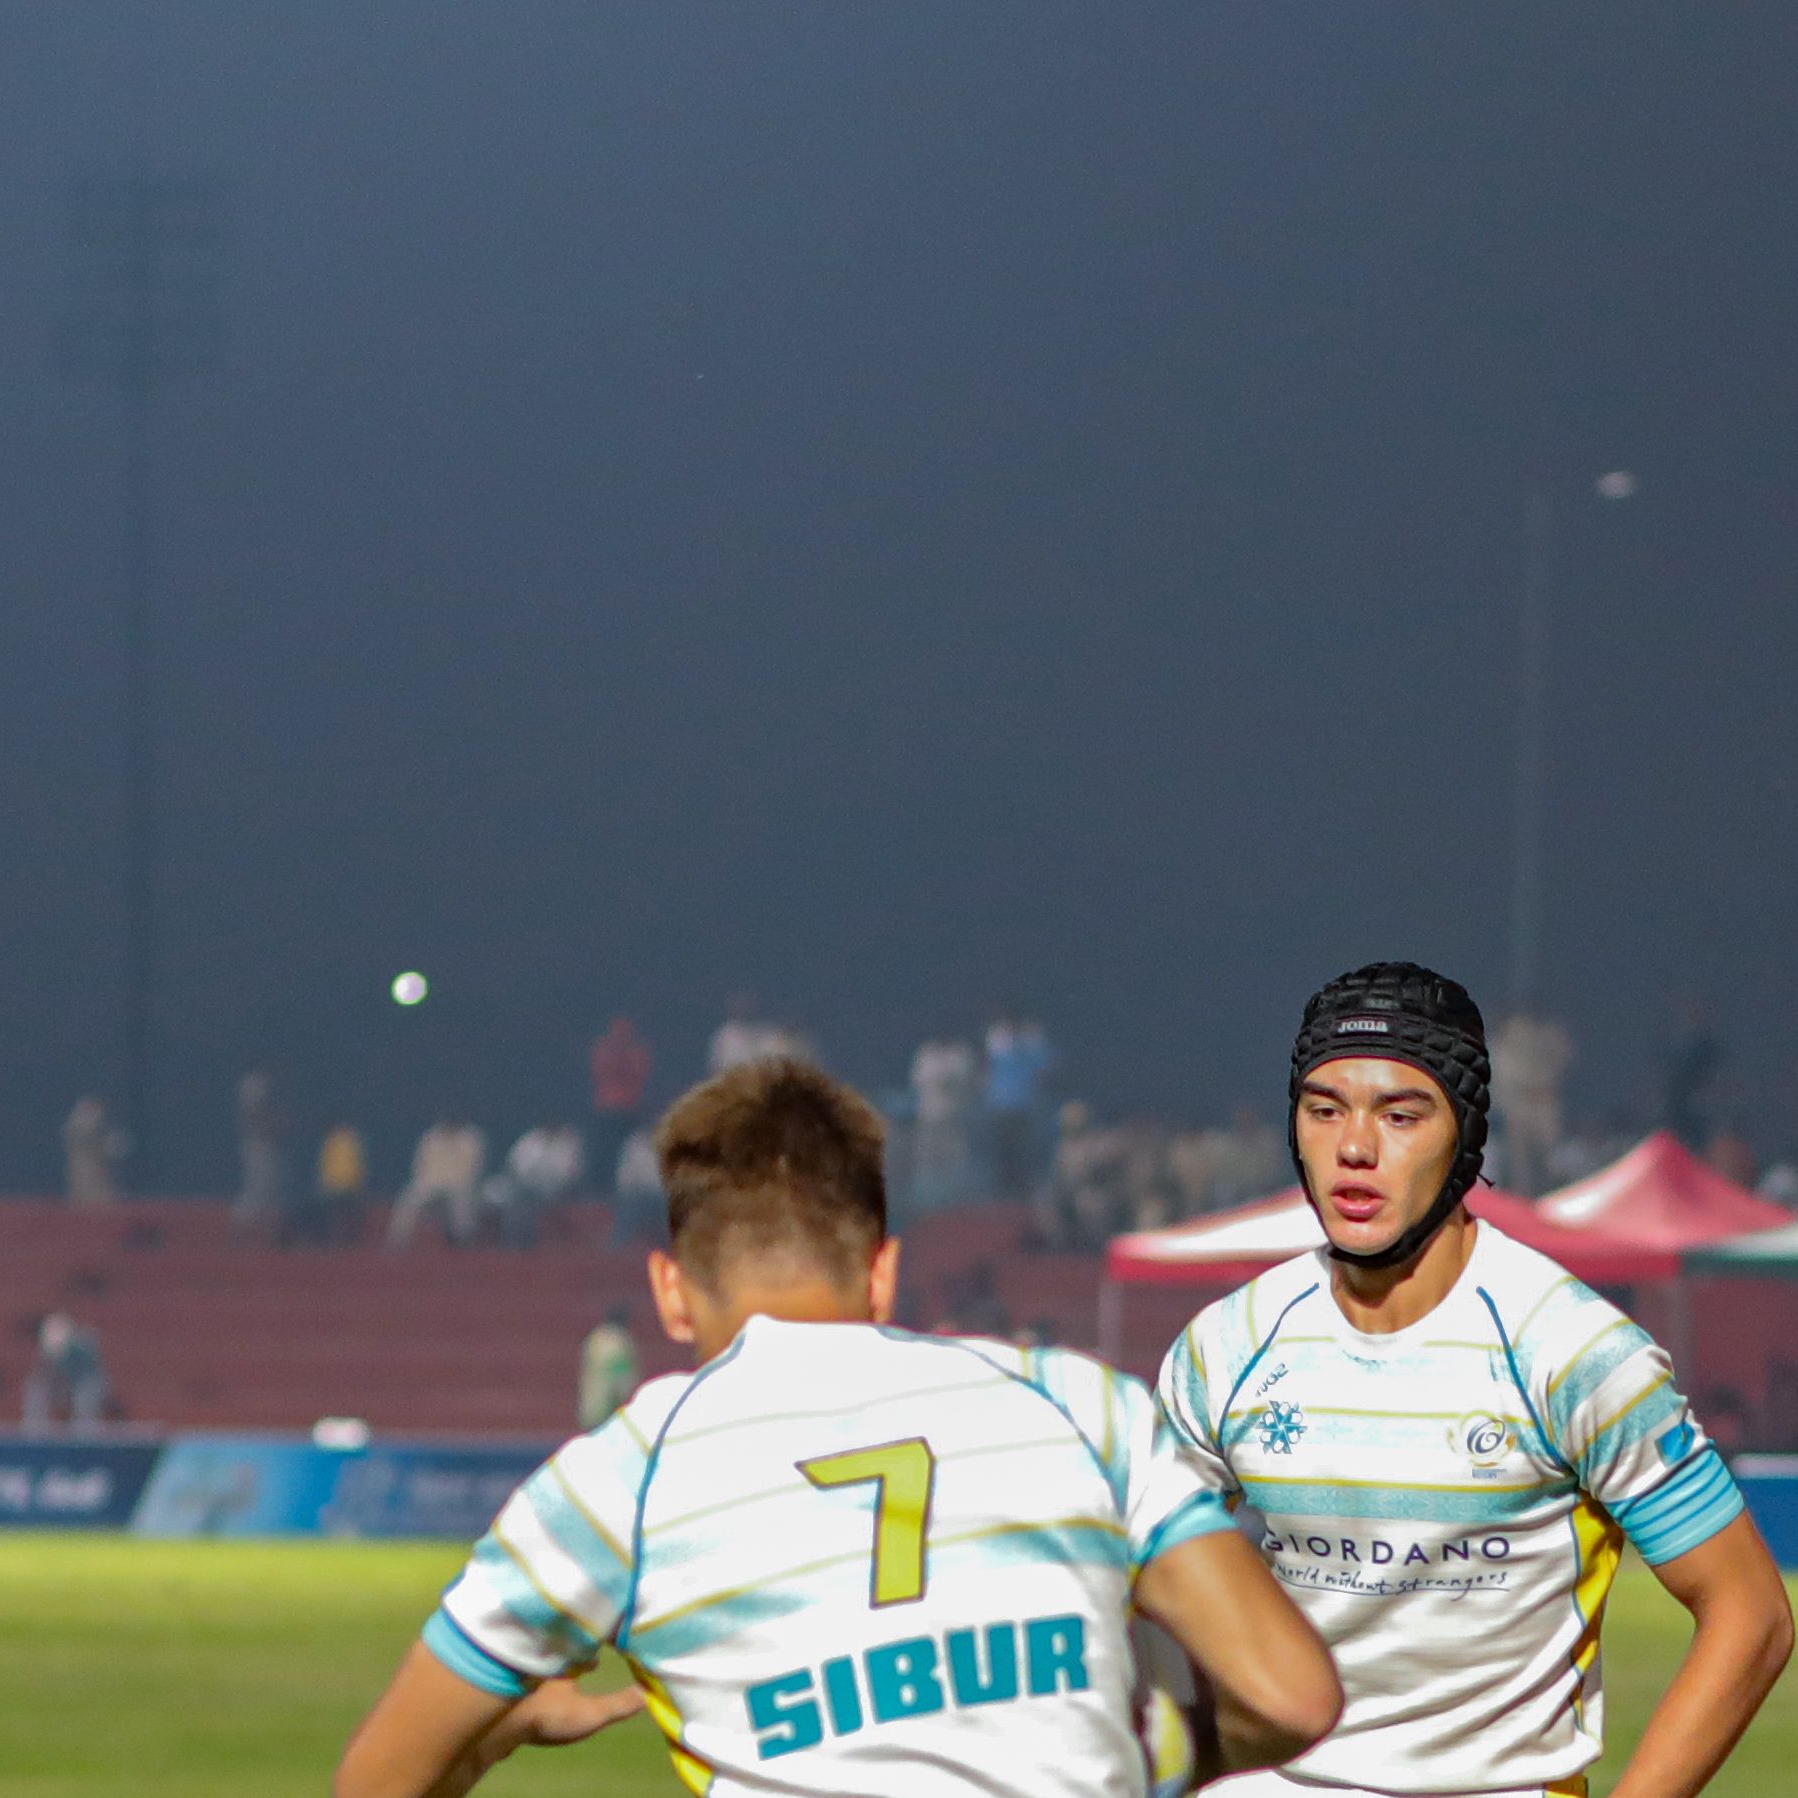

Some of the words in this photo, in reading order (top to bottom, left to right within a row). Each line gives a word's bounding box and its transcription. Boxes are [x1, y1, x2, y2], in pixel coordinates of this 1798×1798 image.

[794, 1435, 937, 1610] 7
[1265, 1529, 1511, 1567] GIORDANO
[743, 1612, 1089, 1762] SIBUR
